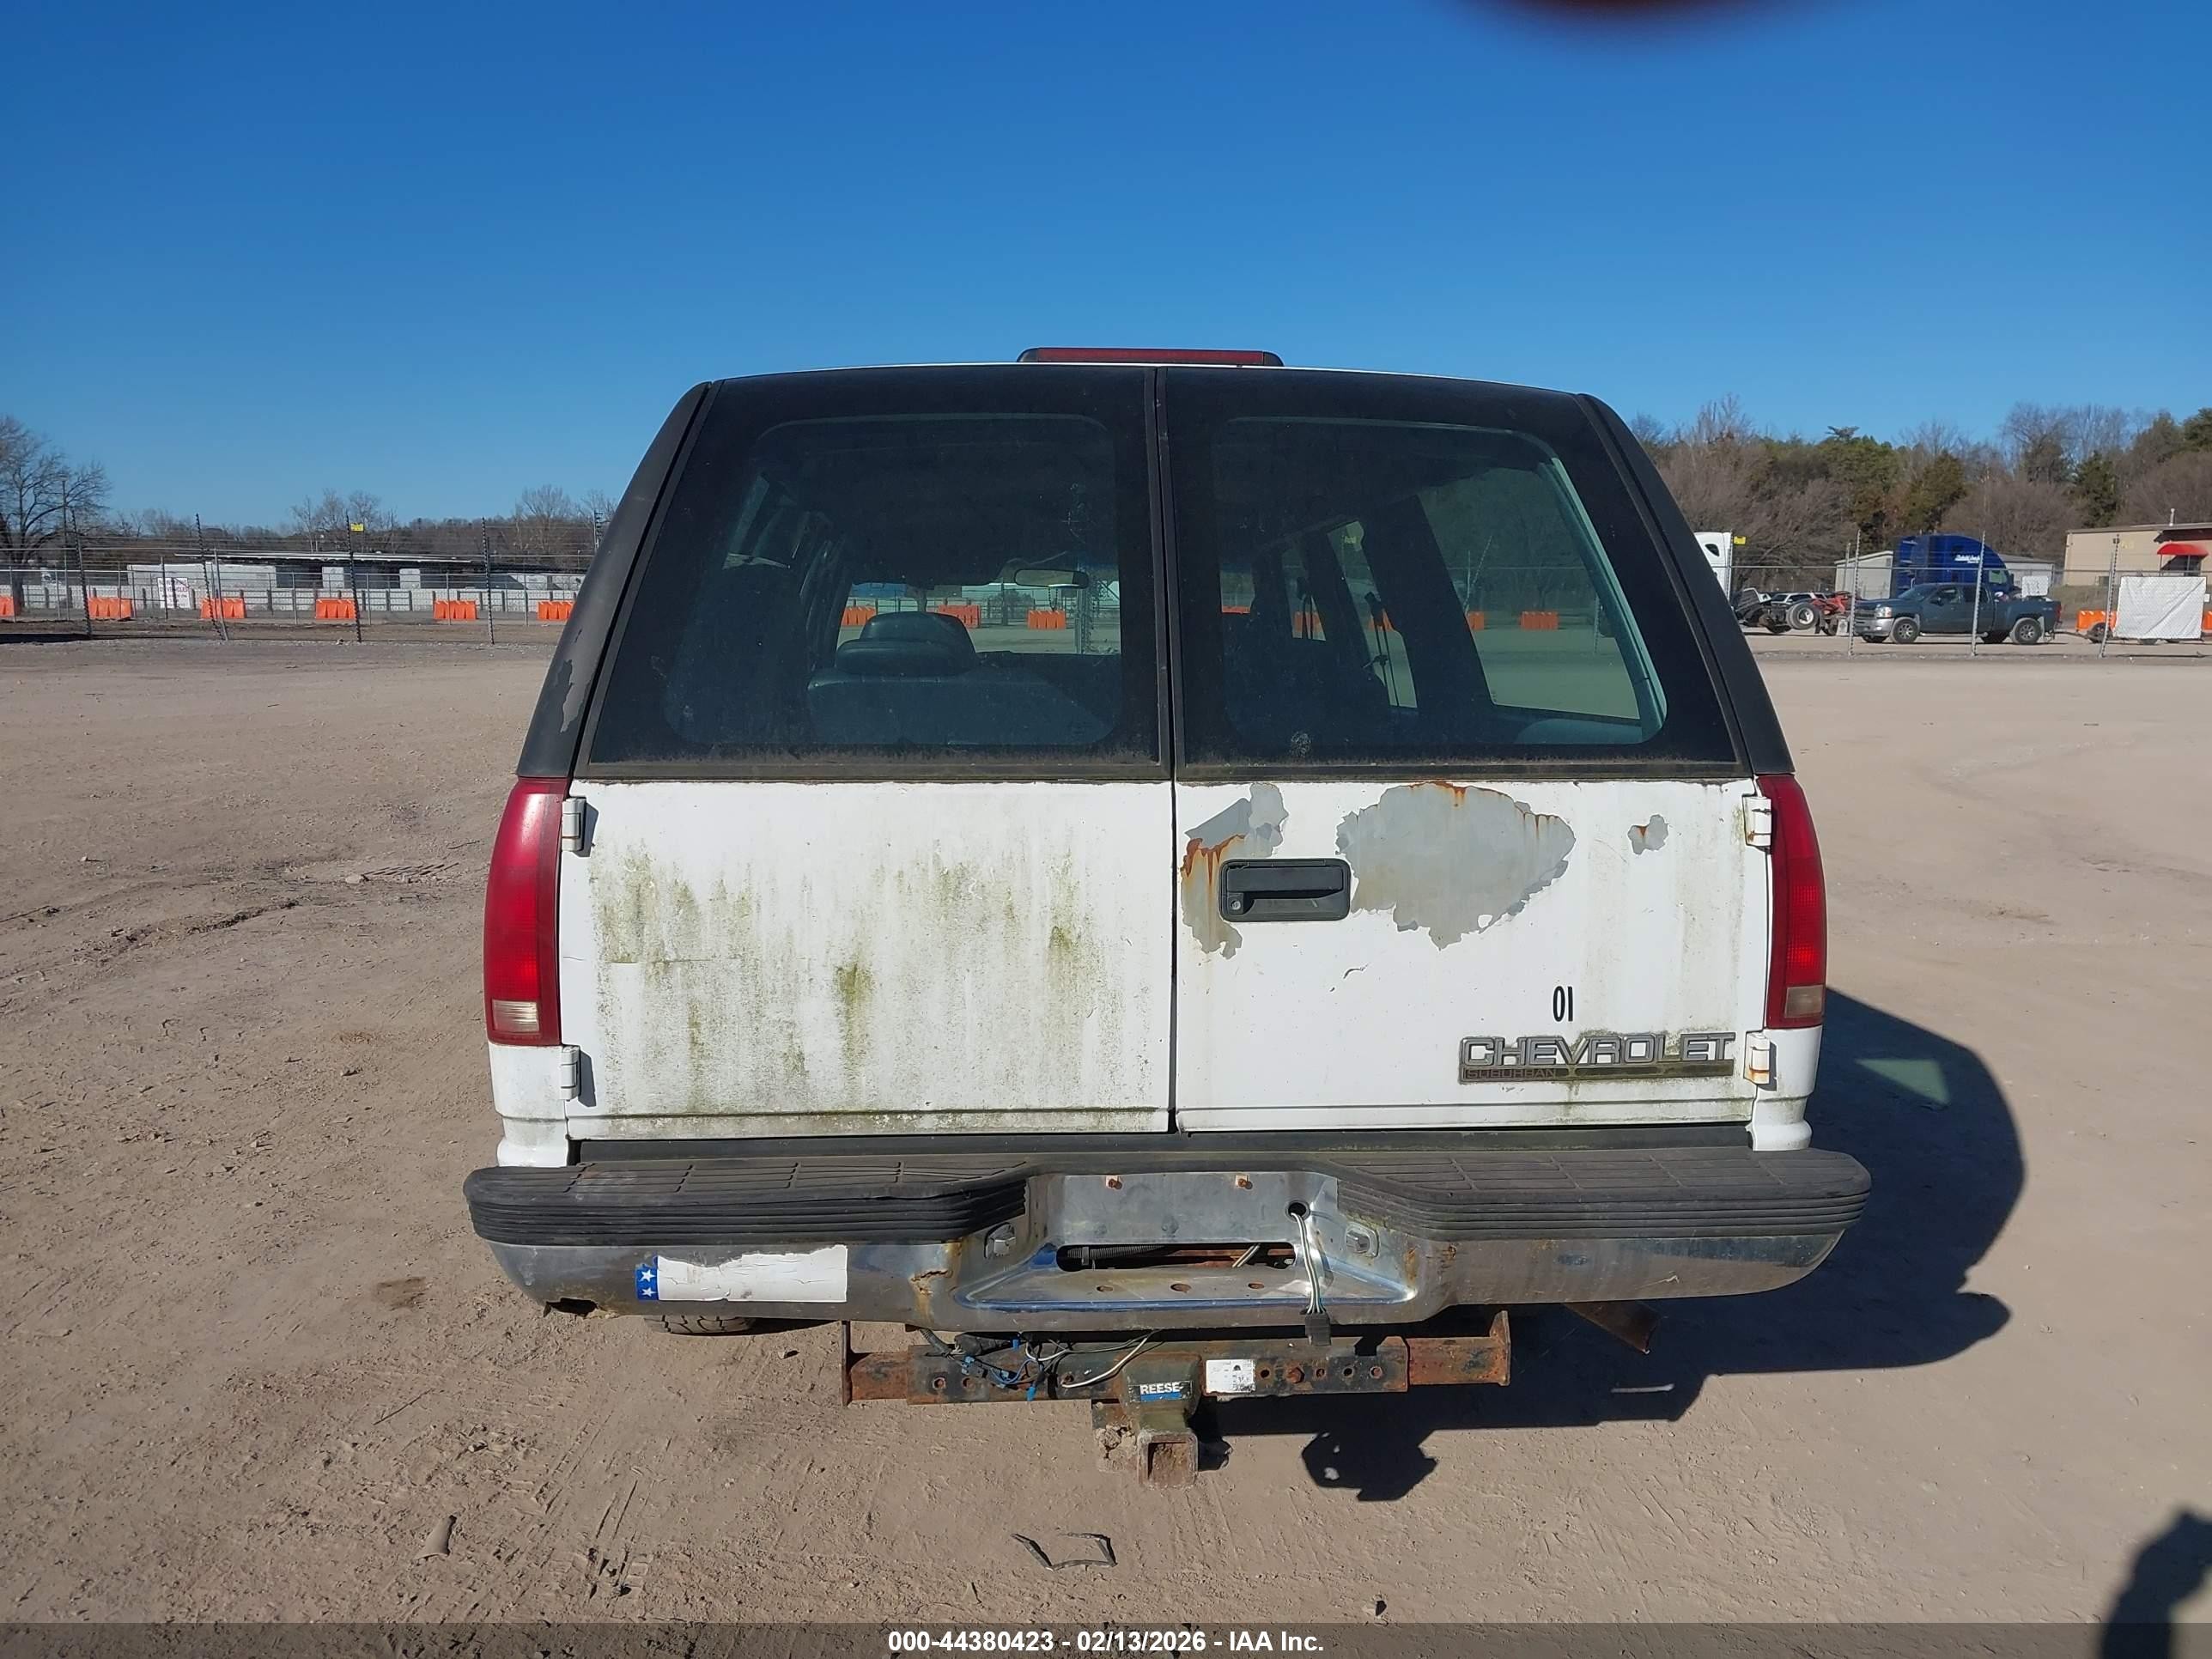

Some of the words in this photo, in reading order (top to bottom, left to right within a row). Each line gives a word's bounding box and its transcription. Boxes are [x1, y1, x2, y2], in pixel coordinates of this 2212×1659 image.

[1462, 1032, 1735, 1066] CHEVROLET
[1466, 1068, 1556, 1079] SUBURBAN
[1140, 1382, 1180, 1395] REESE
